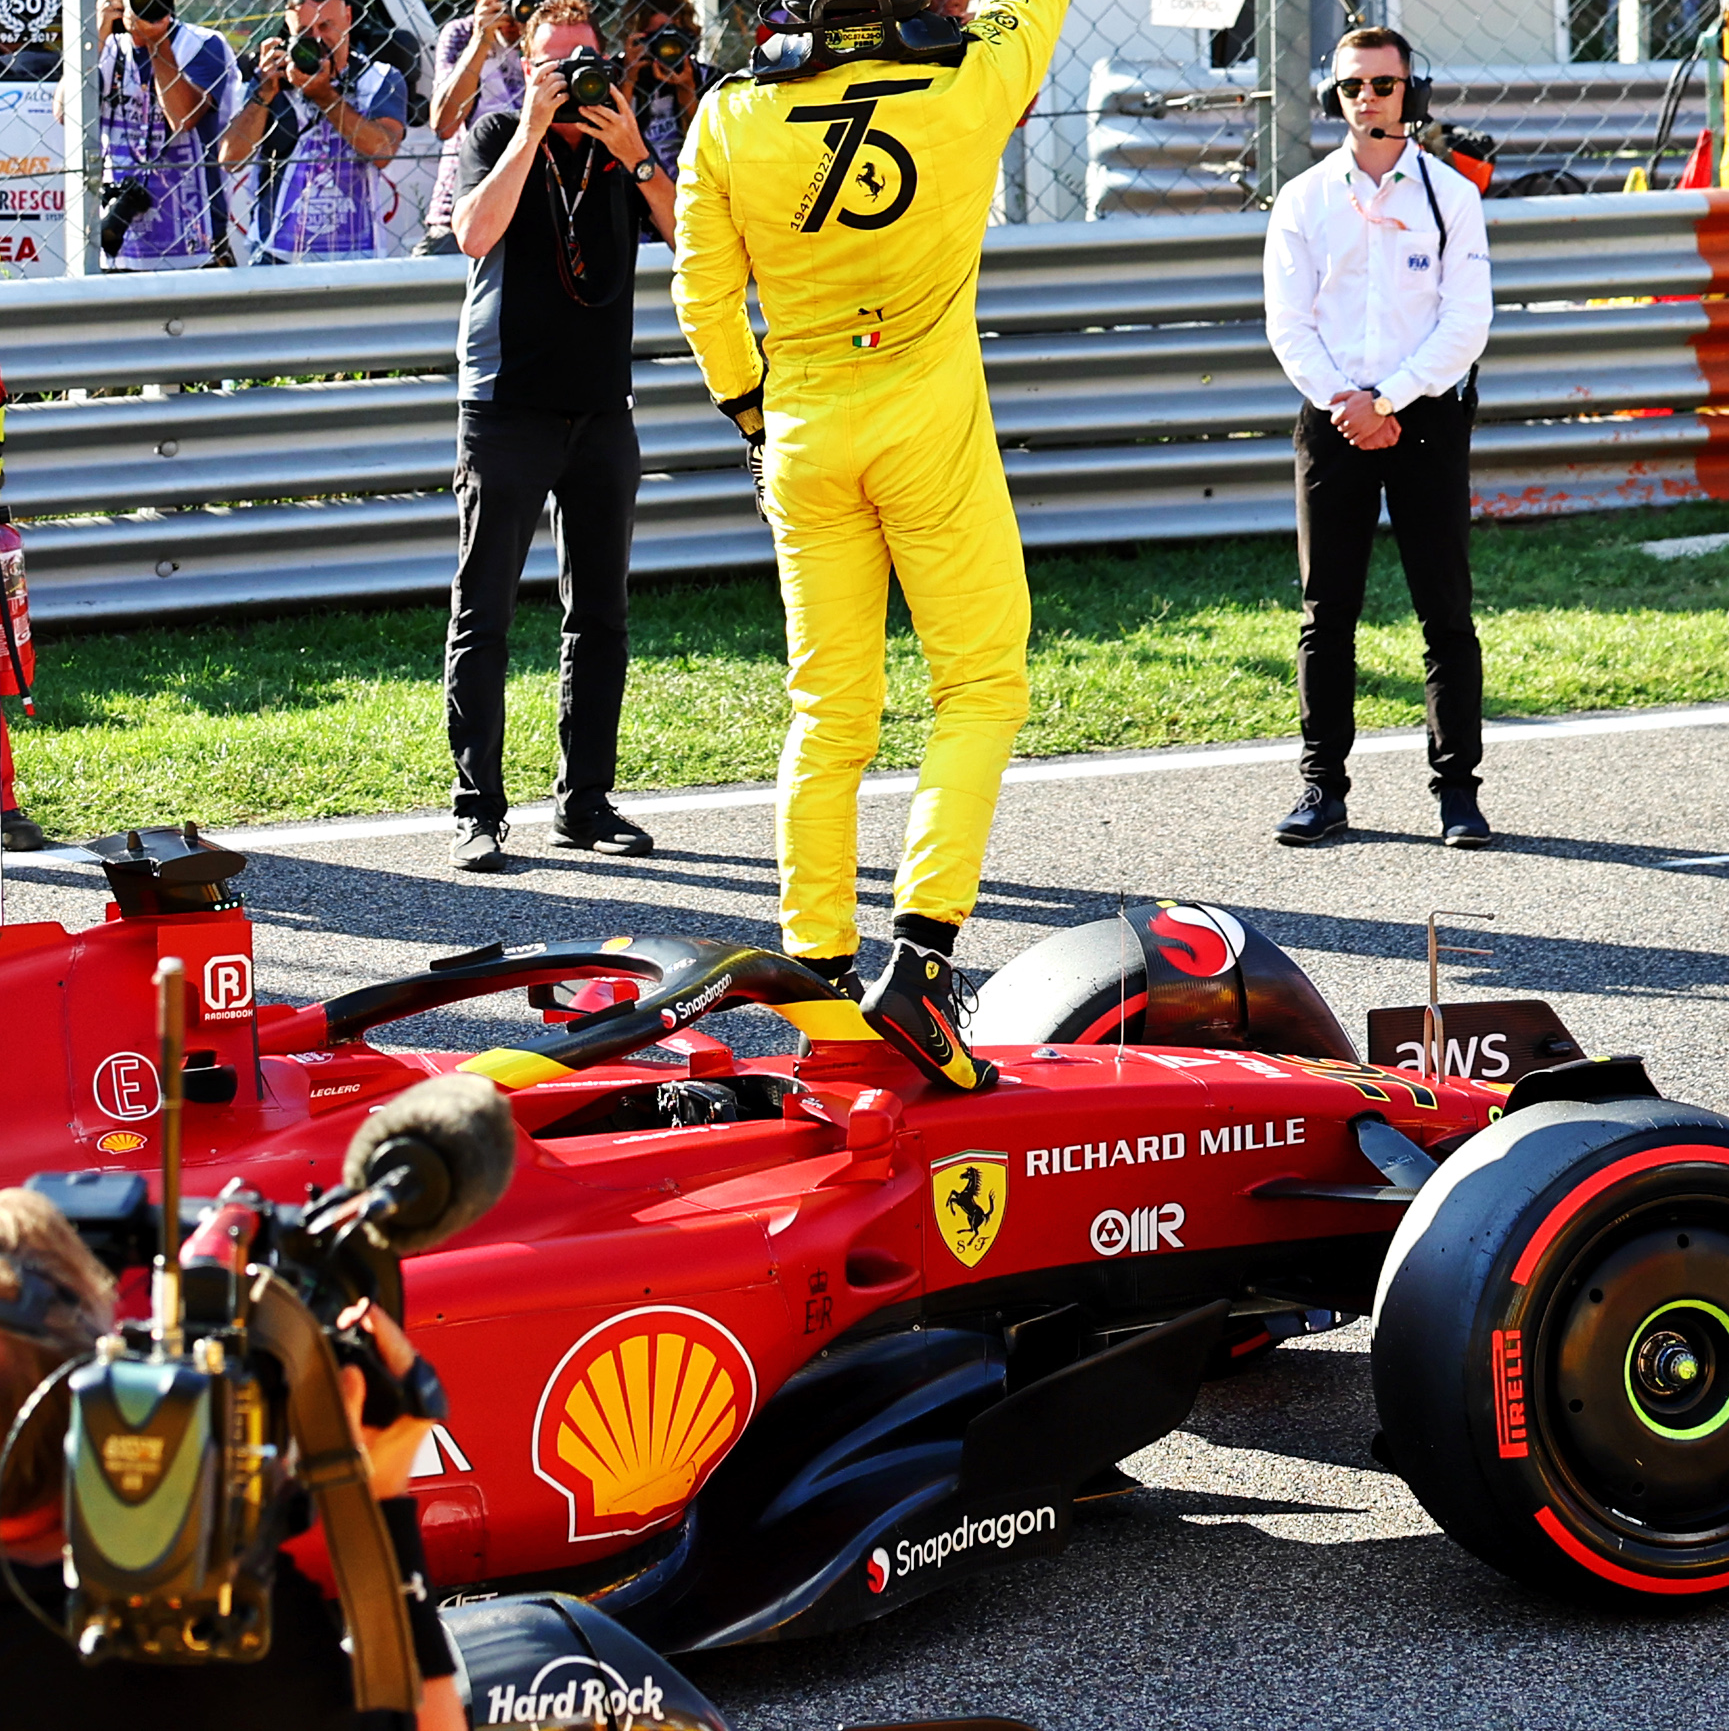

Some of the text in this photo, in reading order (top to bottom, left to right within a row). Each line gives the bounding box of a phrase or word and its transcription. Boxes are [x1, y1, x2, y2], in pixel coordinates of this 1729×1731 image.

[783, 77, 935, 234] 75
[789, 150, 835, 232] 1947-2022
[204, 1009, 254, 1021] RADIOBOOK
[675, 972, 733, 1020] Snapdragon
[1394, 1032, 1511, 1079] aws
[310, 1082, 361, 1099] LECLERC
[1025, 1117, 1307, 1178] RICHARD MILLE
[1491, 1328, 1530, 1460] PIRELLI
[895, 1504, 1058, 1579] Snapdragon
[487, 1673, 666, 1726] Hard Rock
